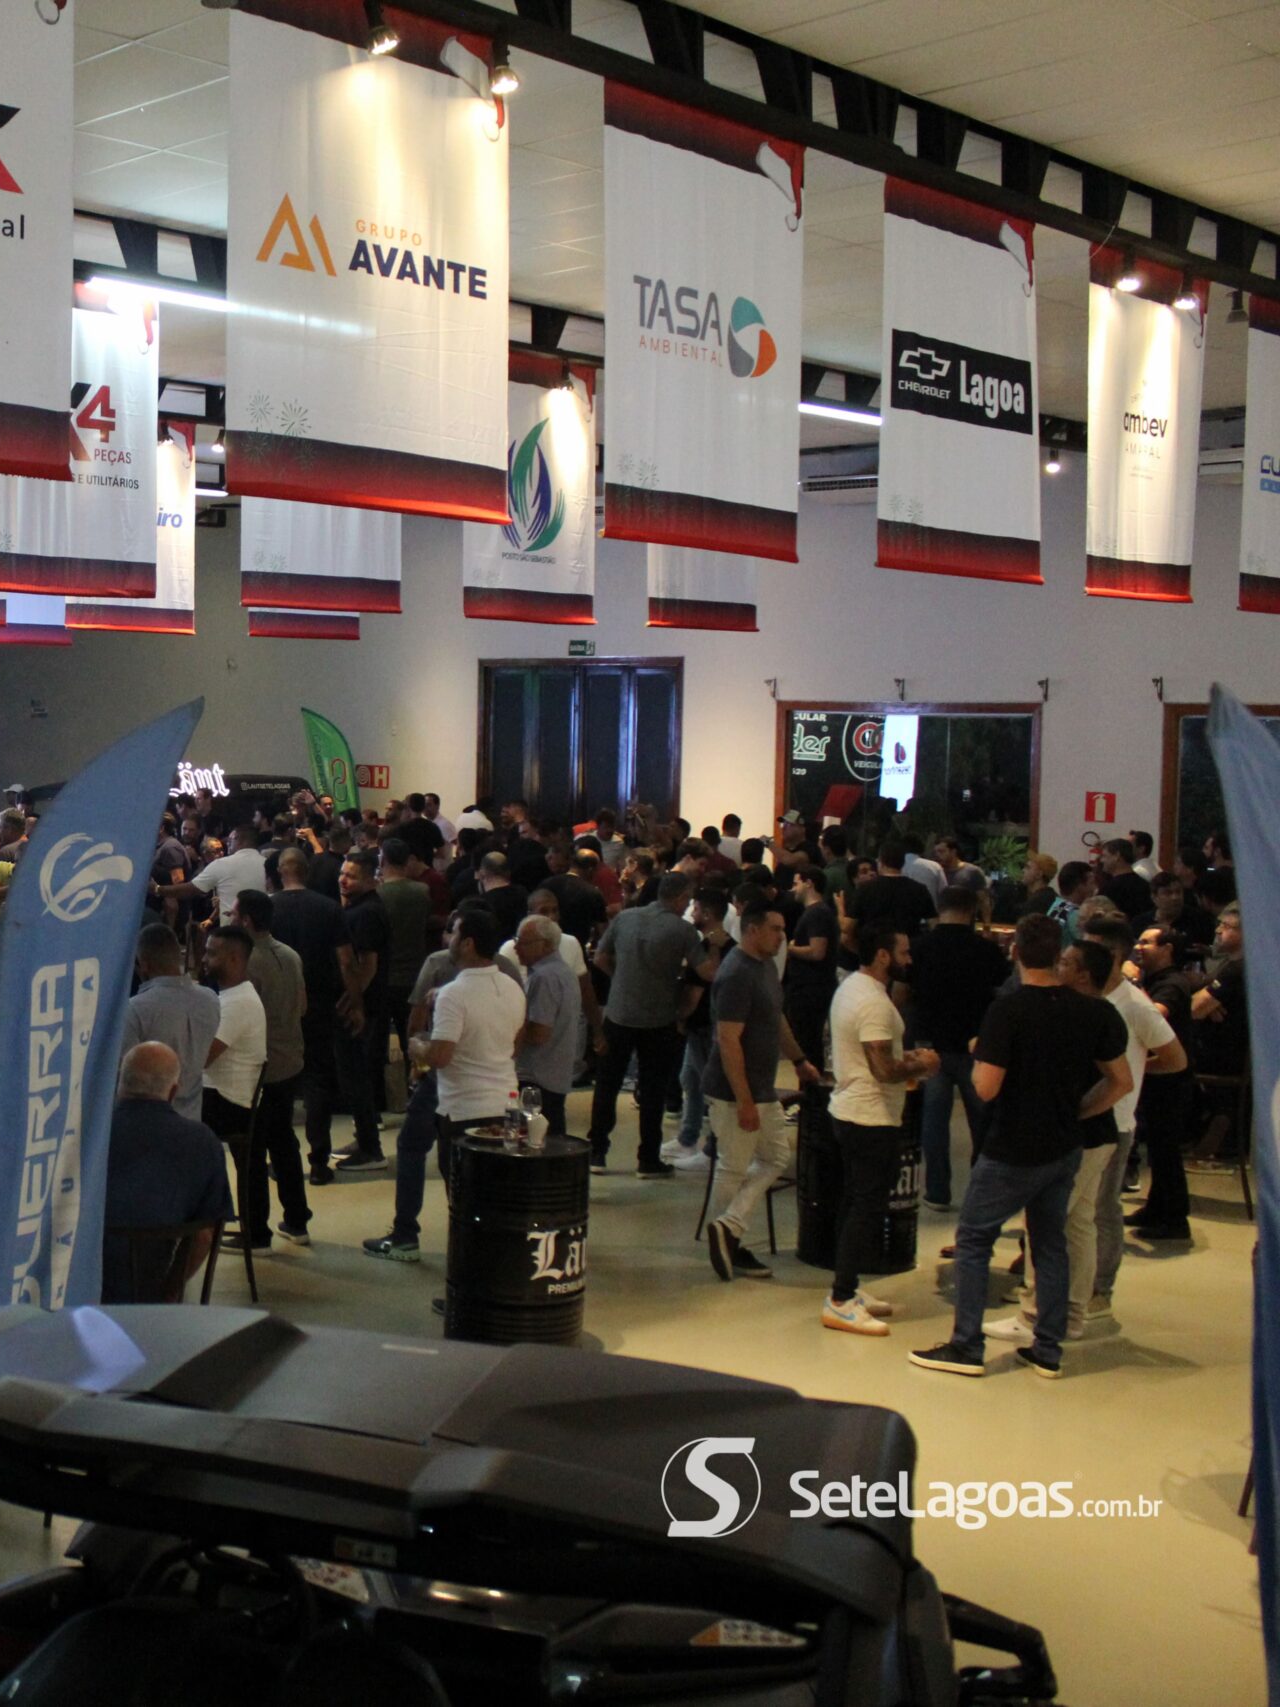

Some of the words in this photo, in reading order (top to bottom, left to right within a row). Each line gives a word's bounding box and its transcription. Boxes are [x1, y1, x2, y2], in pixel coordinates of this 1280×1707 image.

[355, 219, 423, 246] GRUPO
[349, 238, 488, 301] AVANTE
[632, 274, 723, 347] TASA
[639, 334, 724, 368] AMBIENTAL
[897, 379, 952, 400] CHEVROLET
[959, 359, 1026, 420] Lagoa
[93, 447, 132, 465] PEÇAS
[86, 473, 140, 489] UTILITÁRIOS
